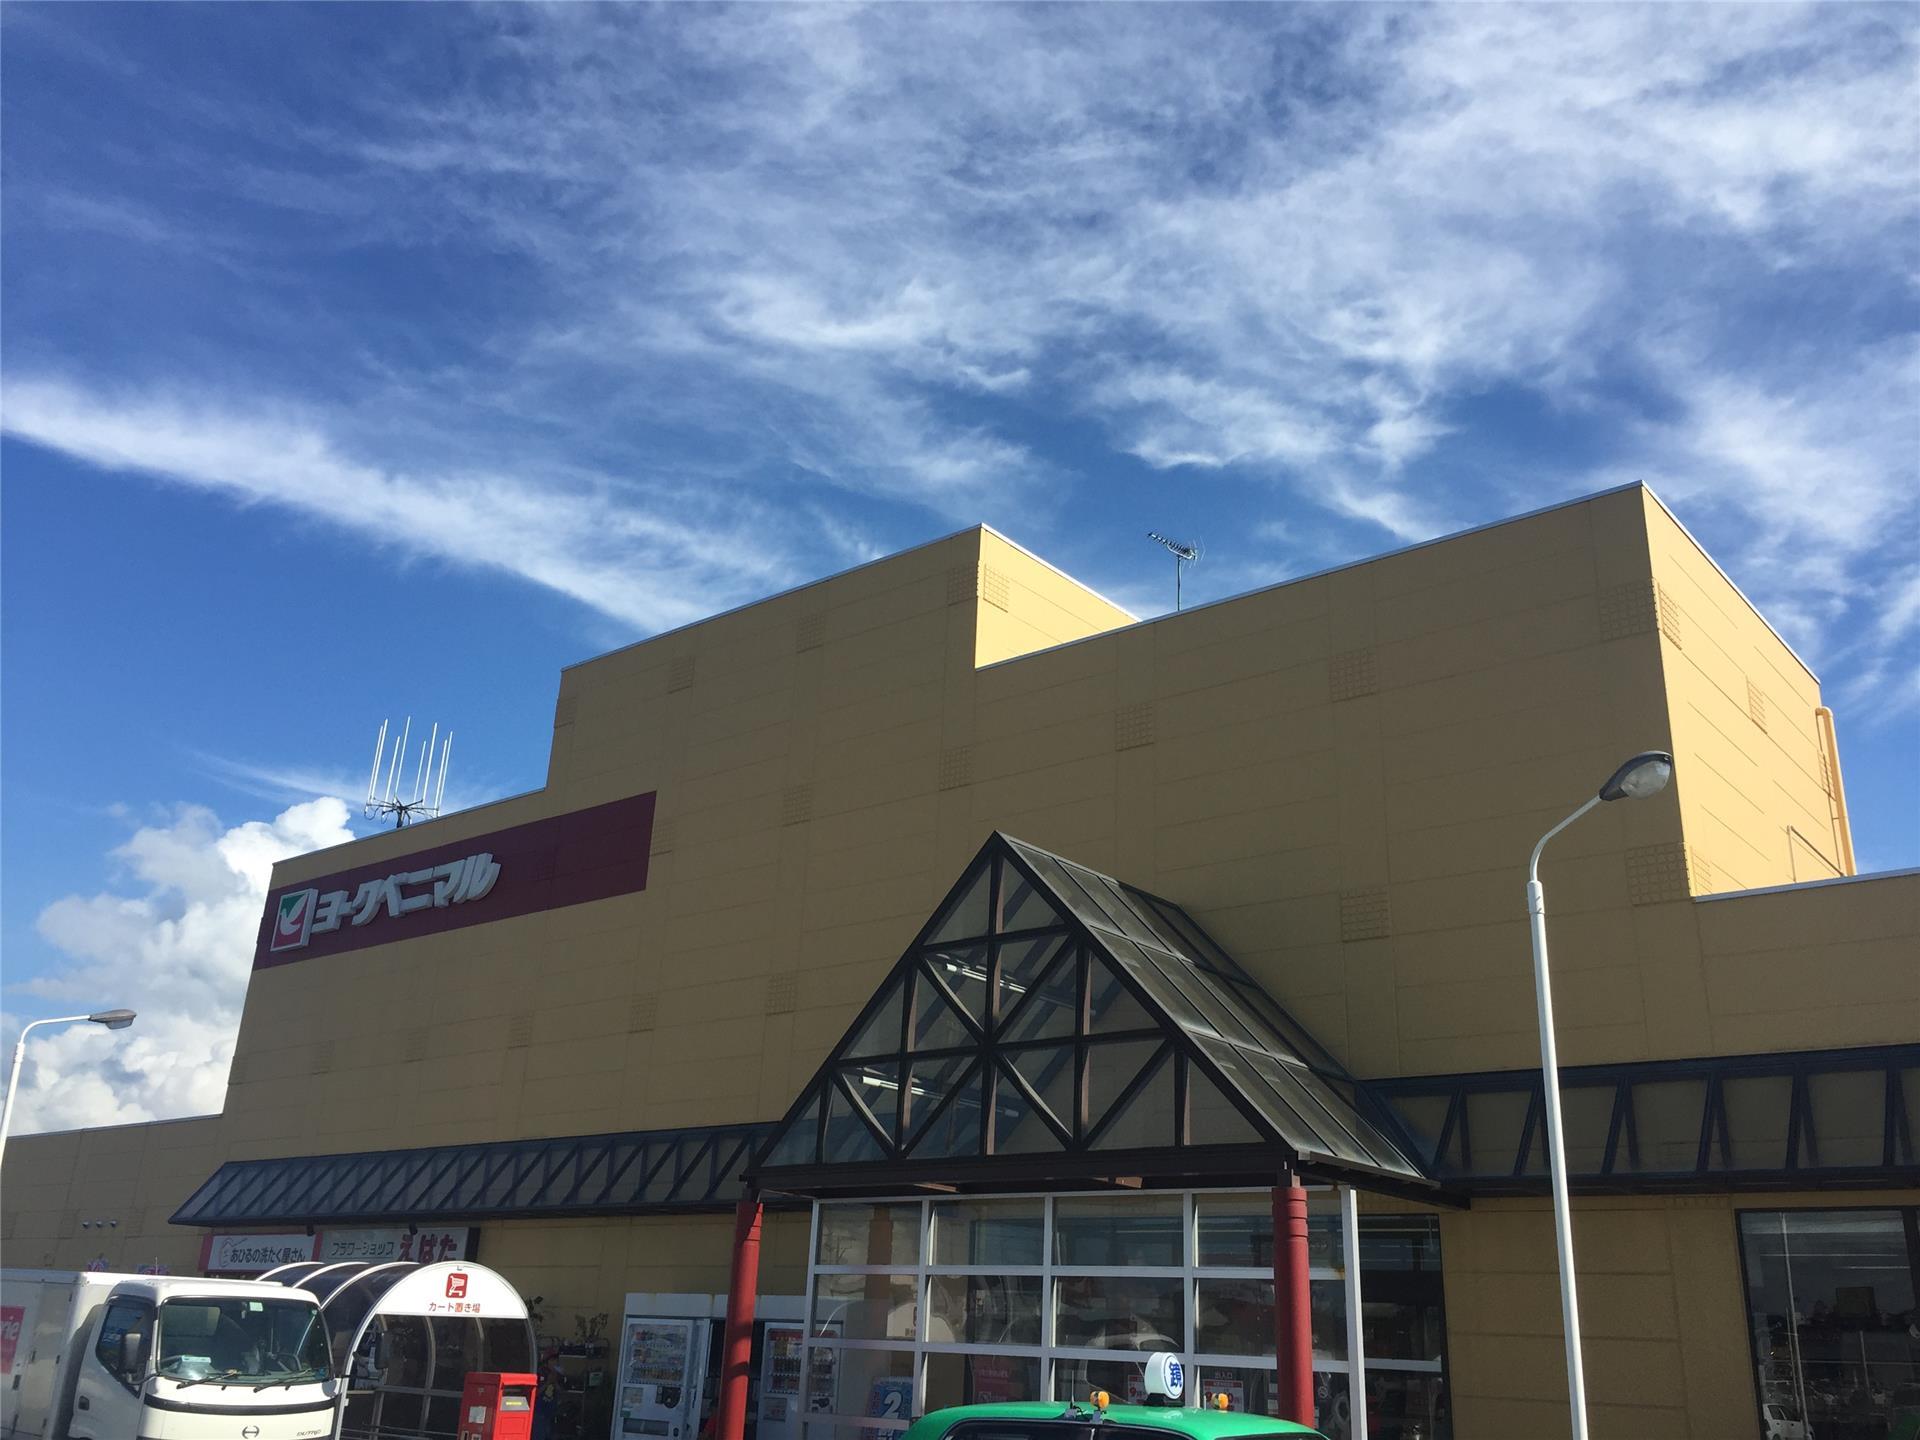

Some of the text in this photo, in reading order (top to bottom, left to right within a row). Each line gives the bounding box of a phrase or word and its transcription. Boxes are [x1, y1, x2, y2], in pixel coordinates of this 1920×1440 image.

[311, 853, 501, 933] ヨークベニマル
[428, 1302, 481, 1314] カート置き場
